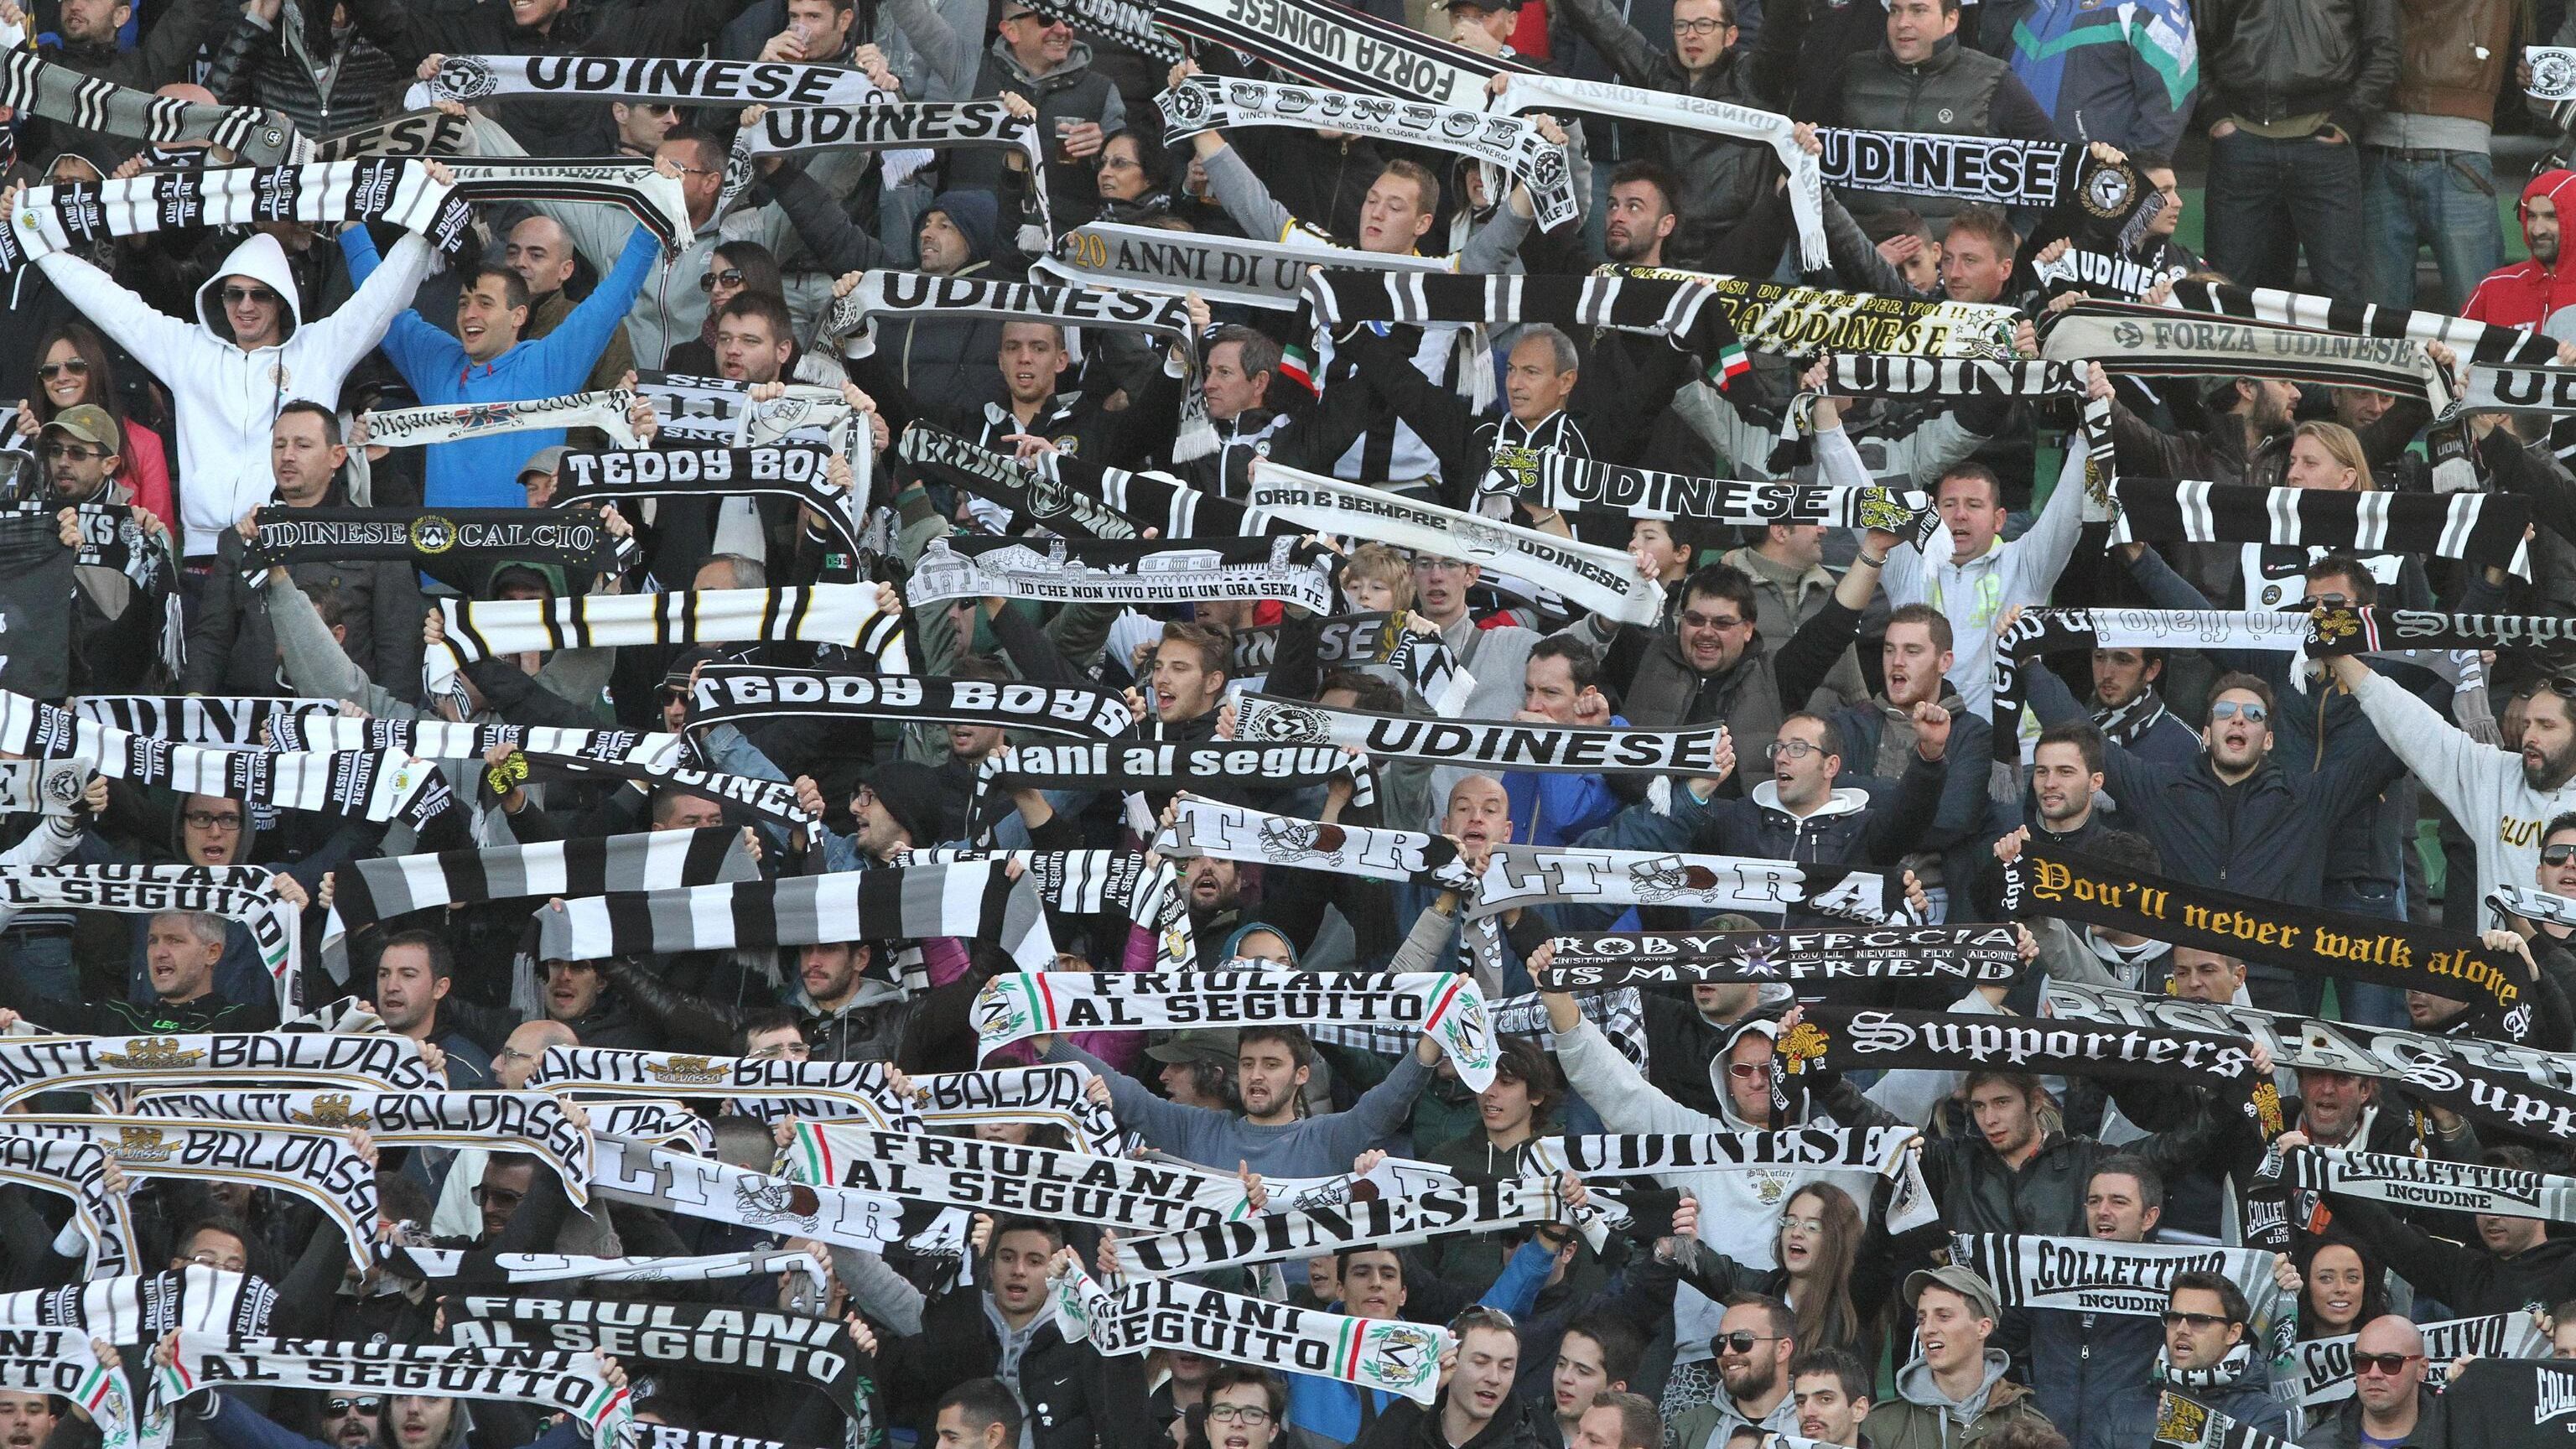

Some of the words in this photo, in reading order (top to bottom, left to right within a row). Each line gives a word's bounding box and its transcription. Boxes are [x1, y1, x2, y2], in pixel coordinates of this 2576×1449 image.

[526, 57, 844, 104] UDINESE
[1354, 44, 1456, 102] FORZA
[1229, 81, 1523, 150] UDINESE
[1239, 111, 1268, 121] VINCI
[1338, 121, 1381, 133] NOSTRO
[1386, 128, 1421, 140] CUORE
[1816, 128, 2060, 201] UDINESE
[1074, 234, 1107, 268] 20
[1115, 240, 1208, 280] ANNI
[1218, 247, 1259, 285] DI
[1757, 284, 1779, 299] DI
[1788, 288, 1857, 308] TIFARE
[1862, 299, 1902, 314] PER
[1908, 302, 1942, 316] VOI
[1778, 307, 1948, 356] UDINESE
[2150, 322, 2258, 353] FORZA
[2274, 331, 2418, 369] UDINESE
[569, 449, 732, 486] TEDDY
[1561, 456, 1832, 520] UDINESE
[259, 522, 408, 548] UDINESE
[458, 522, 594, 550] CALCIO
[1255, 490, 1310, 506] ORA
[1313, 492, 1332, 507] E
[1338, 495, 1448, 531] SEMPRE
[1516, 538, 1630, 596] UDINESE
[1021, 582, 1034, 595] IO
[1038, 584, 1067, 596] CHE
[1072, 585, 1103, 599] NON
[1108, 586, 1144, 599] VIVO
[1179, 586, 1195, 598] DI
[1227, 585, 1257, 596] ORA
[694, 677, 923, 712] TEDDY
[951, 680, 1133, 738] BOYS
[1124, 745, 1174, 776] al
[1368, 719, 1712, 765] UDINESE
[351, 752, 375, 806] RECIDIVA
[1048, 850, 1065, 890] SEGUITO
[1104, 858, 1125, 900] FRIULANI
[1118, 893, 1130, 908] AL
[1553, 934, 1726, 956] ROBY
[1789, 927, 2017, 952] FECCIA
[1854, 948, 1909, 958] NEVER
[1921, 948, 1954, 958] FLY
[1967, 949, 2018, 961] ALONE
[2033, 857, 2168, 921] You'll
[2183, 903, 2301, 949] never
[2312, 926, 2412, 970] walk
[2426, 948, 2518, 1007] alone
[1093, 973, 1397, 996] FRIULANI
[1552, 967, 1604, 986] IS
[1618, 962, 1727, 984] MY
[1789, 958, 2015, 979] FRIEND
[1066, 999, 1143, 1026] AL
[1166, 994, 1425, 1023] SEGUITO
[1846, 1010, 2256, 1079] Supporters
[870, 1131, 1206, 1201] FRIULANI
[1565, 1128, 1893, 1172] UDINESE
[842, 1160, 923, 1195] AL
[949, 1177, 1223, 1229] SEGUITO
[2386, 1183, 2492, 1209] INCUDINE
[1130, 1180, 1524, 1273] UDINESE
[552, 1323, 847, 1384] SEGUITO
[1107, 1312, 1330, 1371] SEGUITO
[200, 1355, 280, 1381] AL
[307, 1358, 595, 1410] SEGUITO
